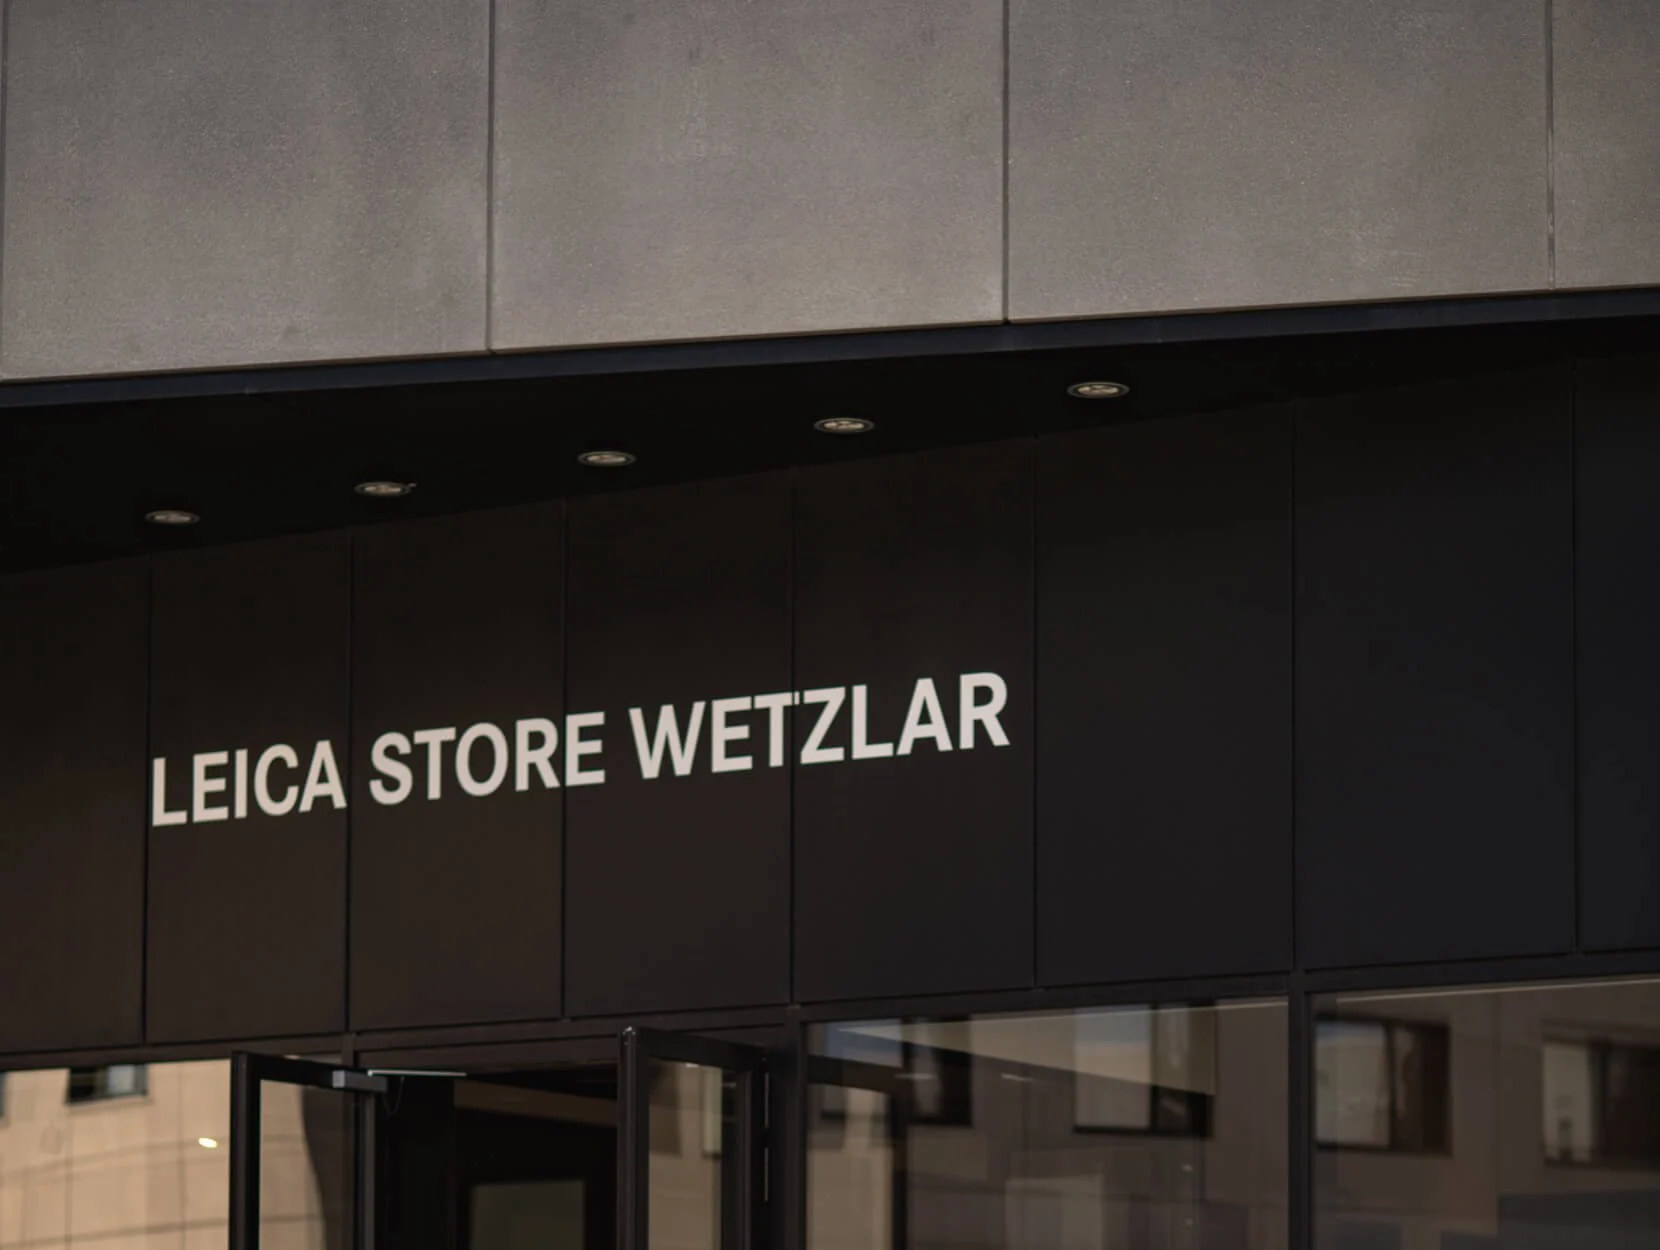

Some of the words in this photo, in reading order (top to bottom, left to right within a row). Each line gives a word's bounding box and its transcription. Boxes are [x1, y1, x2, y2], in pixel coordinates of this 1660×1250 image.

[152, 740, 347, 827] LEICA
[369, 711, 606, 805] STORE
[628, 672, 1010, 780] WETZLAR
